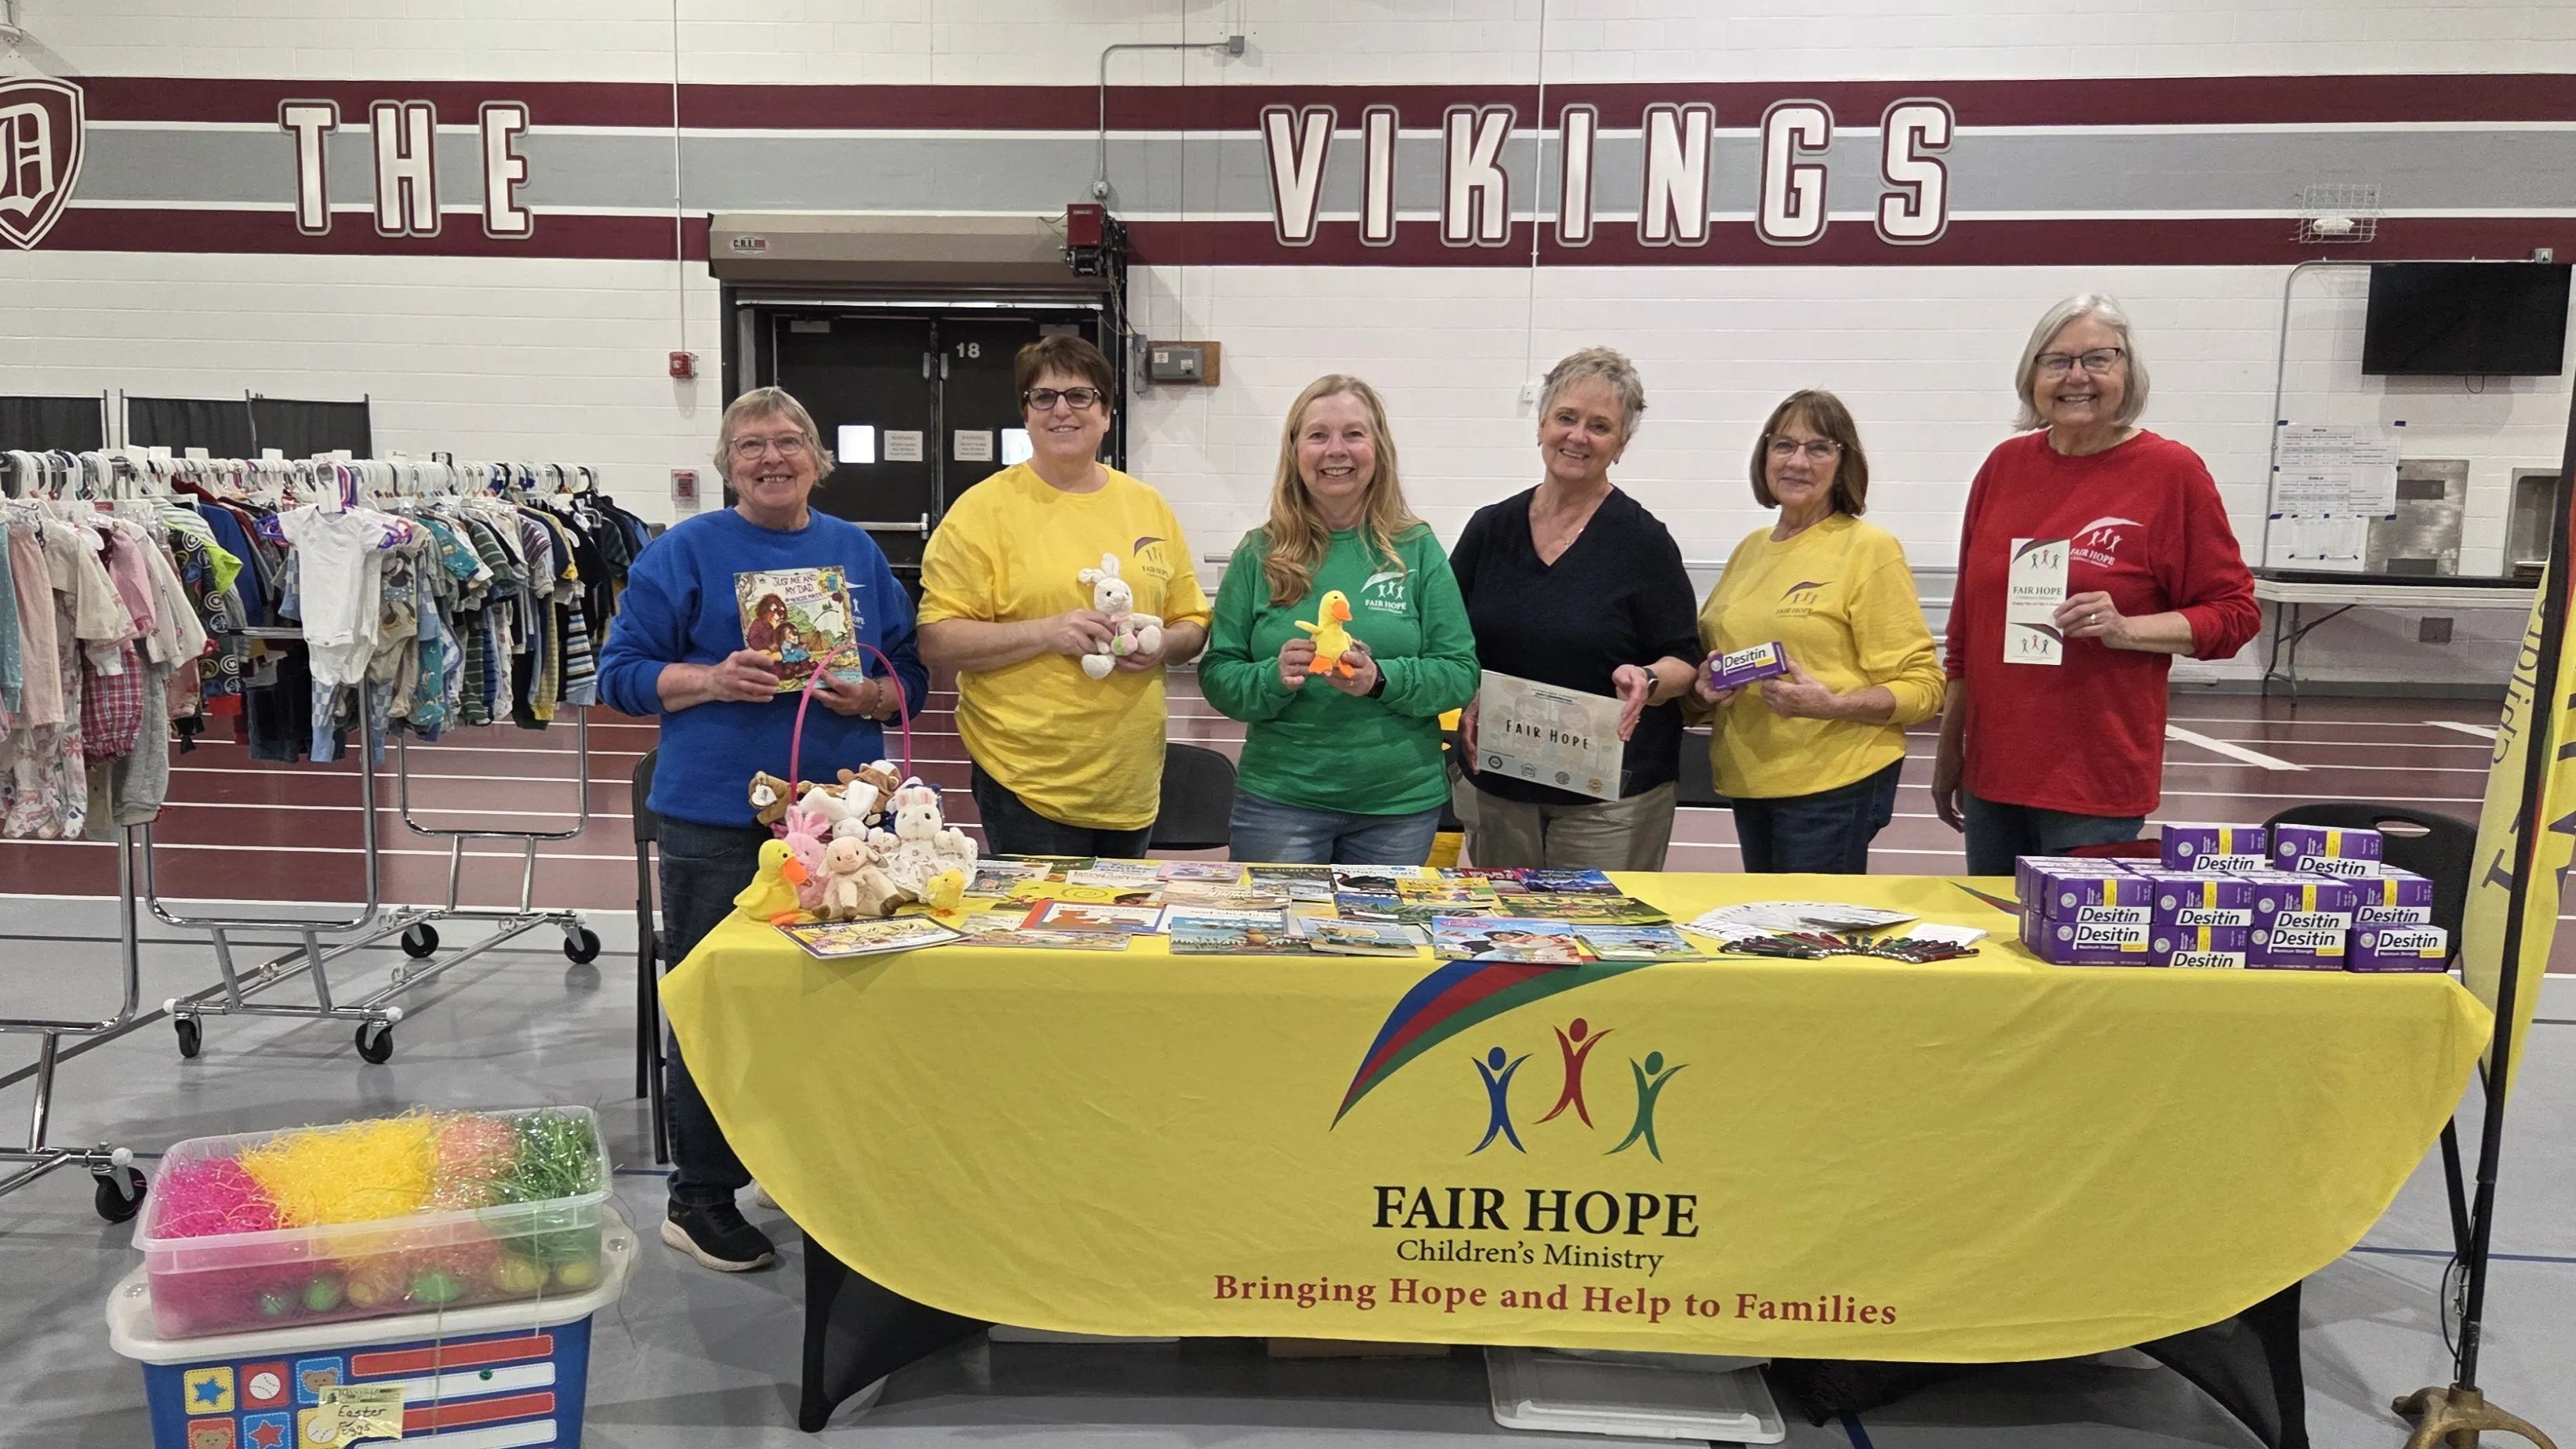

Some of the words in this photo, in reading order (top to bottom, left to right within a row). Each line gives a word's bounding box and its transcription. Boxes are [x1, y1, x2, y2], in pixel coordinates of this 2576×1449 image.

[280, 100, 532, 238] THE
[1262, 100, 1954, 245] VIKINGS
[956, 342, 980, 359] 18
[2069, 548, 2089, 557] FAIR
[2089, 550, 2115, 565] HOPE
[790, 576, 801, 584] ME
[785, 586, 796, 595] MY
[797, 583, 814, 594] DAD
[2013, 586, 2034, 594] FAIR
[2035, 586, 2063, 596] HOPE
[1365, 599, 1384, 608] FAIR
[1385, 601, 1407, 610] HOPE
[1724, 648, 1767, 669] Desitin
[1506, 719, 1541, 738] FAIR
[1550, 728, 1589, 750] HOPE
[2196, 855, 2255, 871] Desitin
[2299, 856, 2367, 877] Desitin
[2080, 907, 2140, 923] Desitin
[2180, 910, 2240, 925] Desitin
[2277, 913, 2340, 928] Desitin
[2360, 907, 2419, 923] Desitin
[2077, 925, 2140, 942] Desitin
[2273, 929, 2336, 946] Desitin
[2379, 932, 2438, 948] Desitin
[2173, 953, 2234, 968] Desitin
[1372, 1186, 1509, 1230] FAIR
[1523, 1189, 1699, 1237] HOPE
[1397, 1239, 1535, 1265] Children's
[1543, 1244, 1664, 1277] Ministry
[1214, 1274, 1376, 1310] Bringing
[1389, 1278, 1487, 1313] Hope
[1500, 1284, 1568, 1310] and
[1582, 1286, 1671, 1324] Help
[1684, 1293, 1720, 1318] to
[1734, 1293, 1897, 1325] Families
[337, 1405, 387, 1418] Easter
[339, 1421, 372, 1436] Eggs
